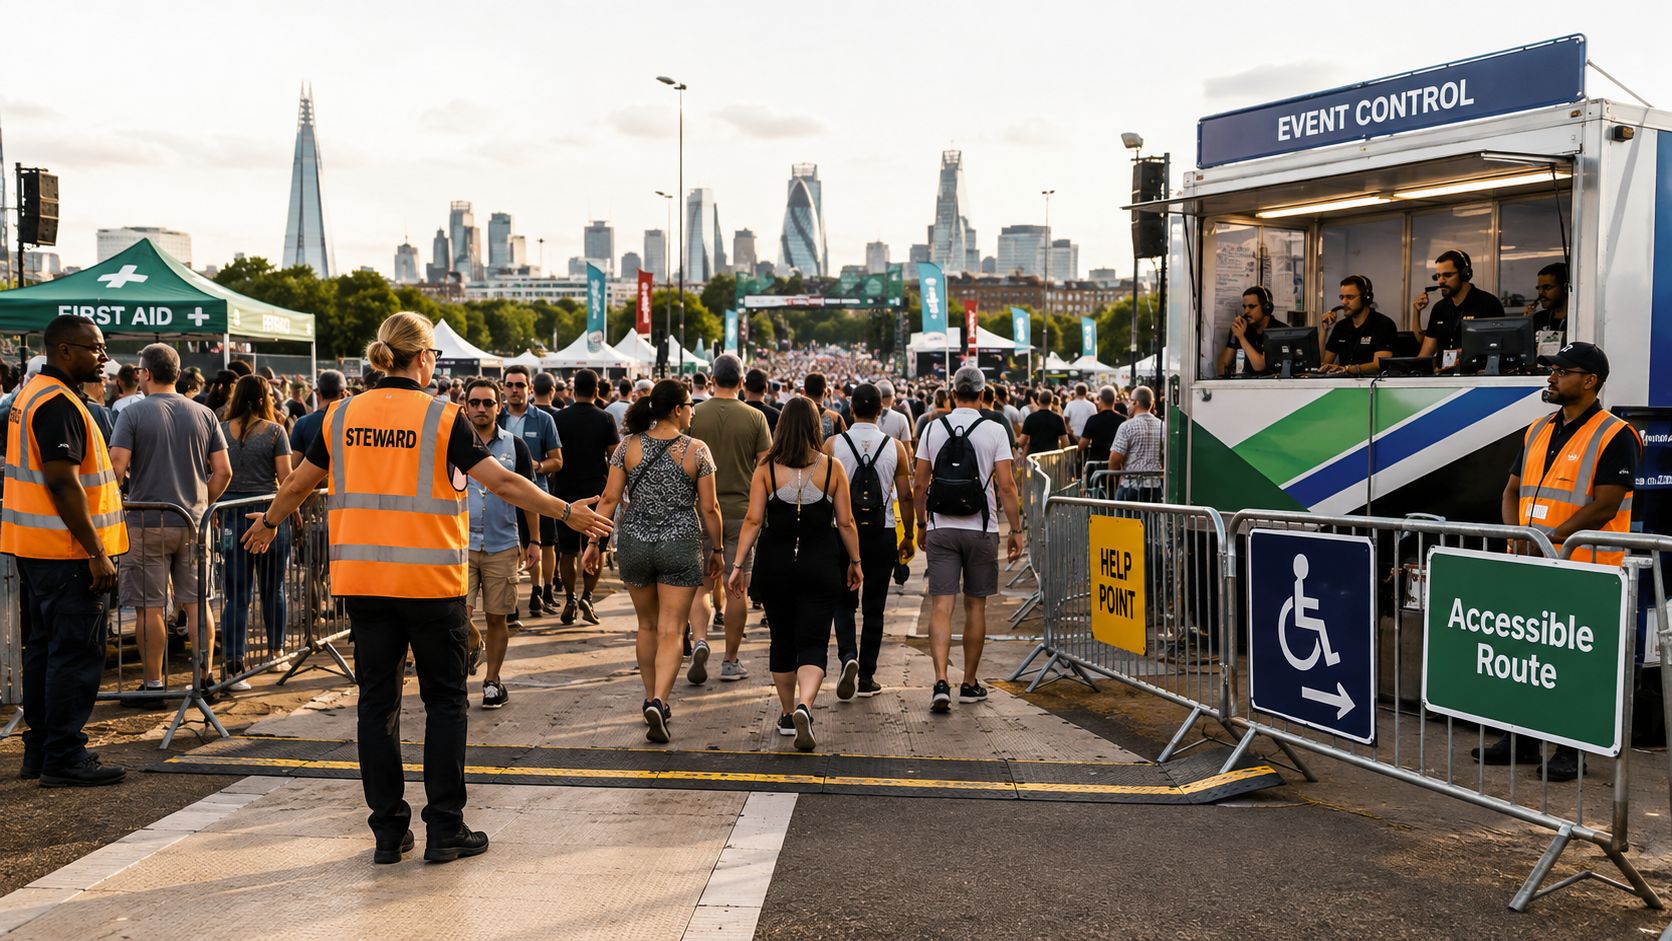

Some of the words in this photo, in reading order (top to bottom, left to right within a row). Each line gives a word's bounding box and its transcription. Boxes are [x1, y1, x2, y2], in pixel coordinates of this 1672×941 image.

[1277, 104, 1350, 142] EVENT
[1355, 78, 1475, 126] CONTROL
[131, 306, 173, 326] AID
[345, 427, 417, 449] STEWARD
[1100, 547, 1132, 581] HELP
[1099, 583, 1136, 620] POINT
[1447, 597, 1595, 653] Accessible
[1476, 642, 1558, 690] Route
